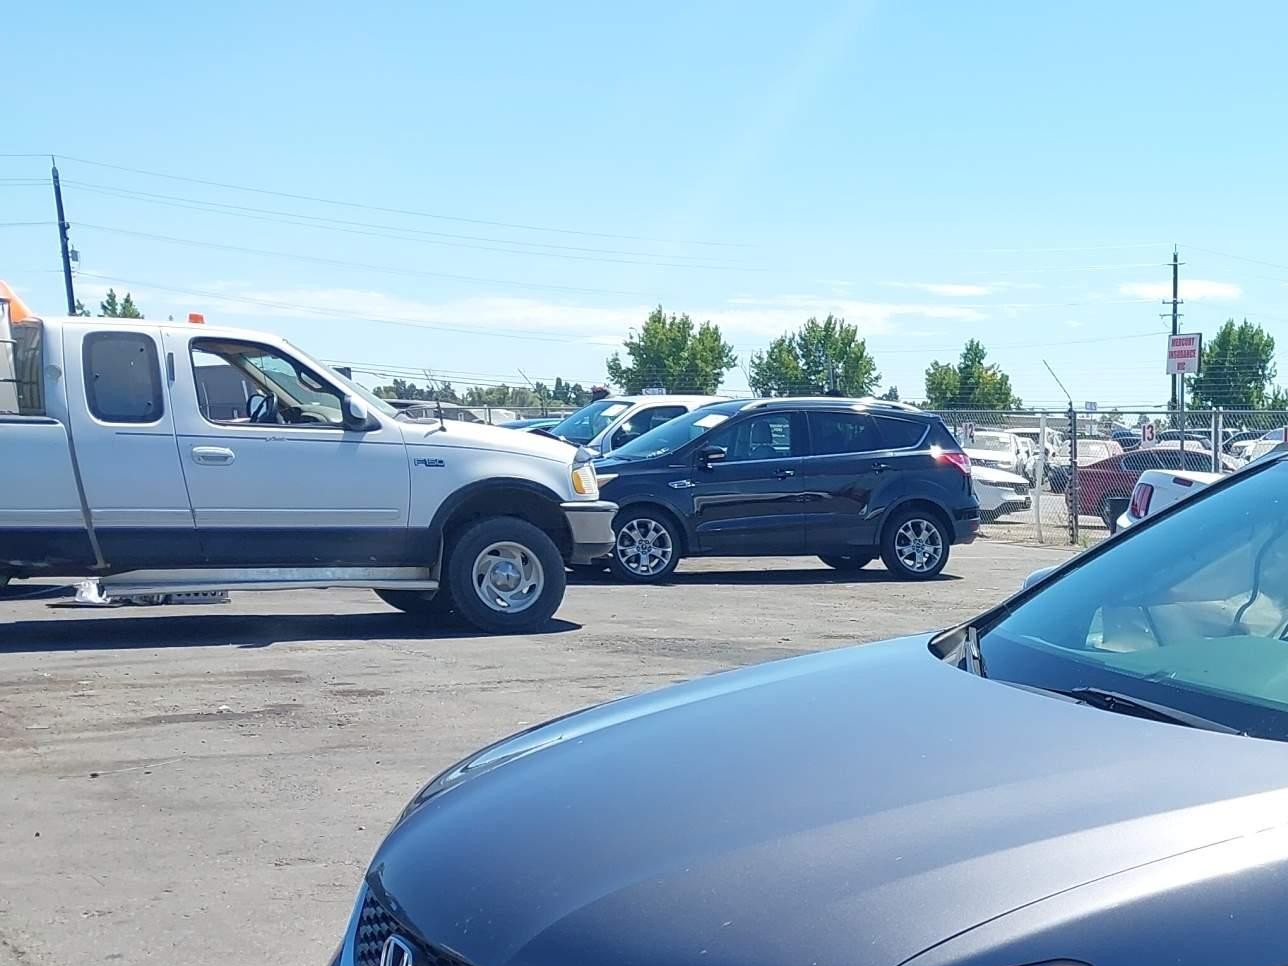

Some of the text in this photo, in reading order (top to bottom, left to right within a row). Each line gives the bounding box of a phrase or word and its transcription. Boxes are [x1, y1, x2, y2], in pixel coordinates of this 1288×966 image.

[1171, 337, 1195, 347] MERCURY
[1168, 349, 1197, 359] INSURANCE
[1142, 424, 1155, 442] 13
